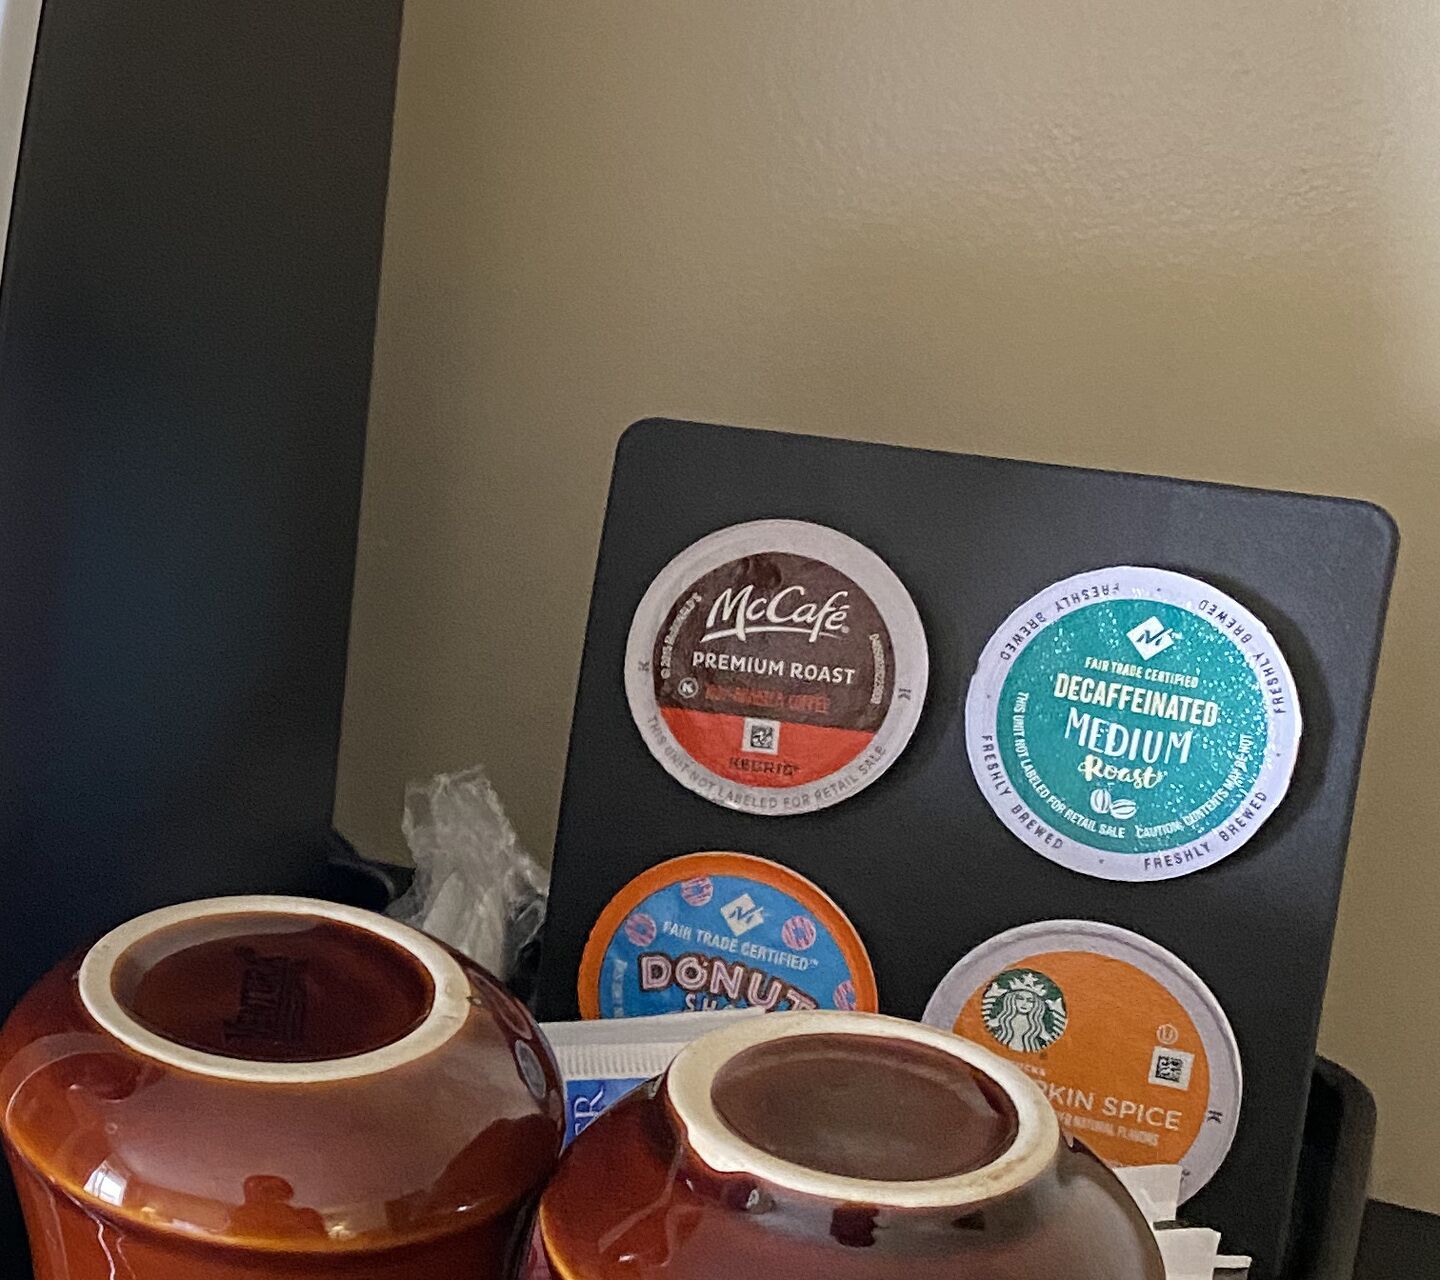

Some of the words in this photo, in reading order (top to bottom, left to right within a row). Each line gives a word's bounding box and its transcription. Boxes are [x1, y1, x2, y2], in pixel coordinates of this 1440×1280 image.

[703, 584, 851, 643] McCafé
[1055, 583, 1120, 613] FRESHLY
[1000, 612, 1047, 661] BREWED
[1197, 599, 1253, 644] BREWED
[692, 651, 785, 677] PREMIUM
[789, 662, 857, 684] ROAST
[1084, 656, 1109, 672] FAIR
[1111, 661, 1143, 679] TRADE
[1145, 667, 1199, 689] CERTIFIED
[1252, 651, 1287, 715] FRESHLY
[1013, 691, 1030, 713] THIS
[1054, 673, 1219, 728] DECAFFEINATED
[1013, 715, 1025, 737] UNIT
[1065, 707, 1194, 765] MEDIUM
[1014, 737, 1030, 759] NOT
[689, 771, 716, 790] NOT
[717, 786, 778, 809] LABELED
[783, 794, 810, 807] FOR
[814, 774, 860, 800] RETAIL
[858, 746, 886, 776] SALE
[1020, 759, 1051, 799] LABELED
[1077, 753, 1165, 789] Roast
[981, 734, 1013, 797] FRESHLY
[1011, 803, 1064, 850] BREWED
[1046, 793, 1068, 814] FOR
[1063, 809, 1097, 833] RETAIL
[1098, 823, 1126, 839] SALE
[1143, 841, 1211, 871] FRESHLY
[1218, 790, 1268, 842] BREWED
[662, 920, 693, 941] FAIR
[696, 929, 739, 953] TRADE
[1102, 1096, 1183, 1132] SPICE
